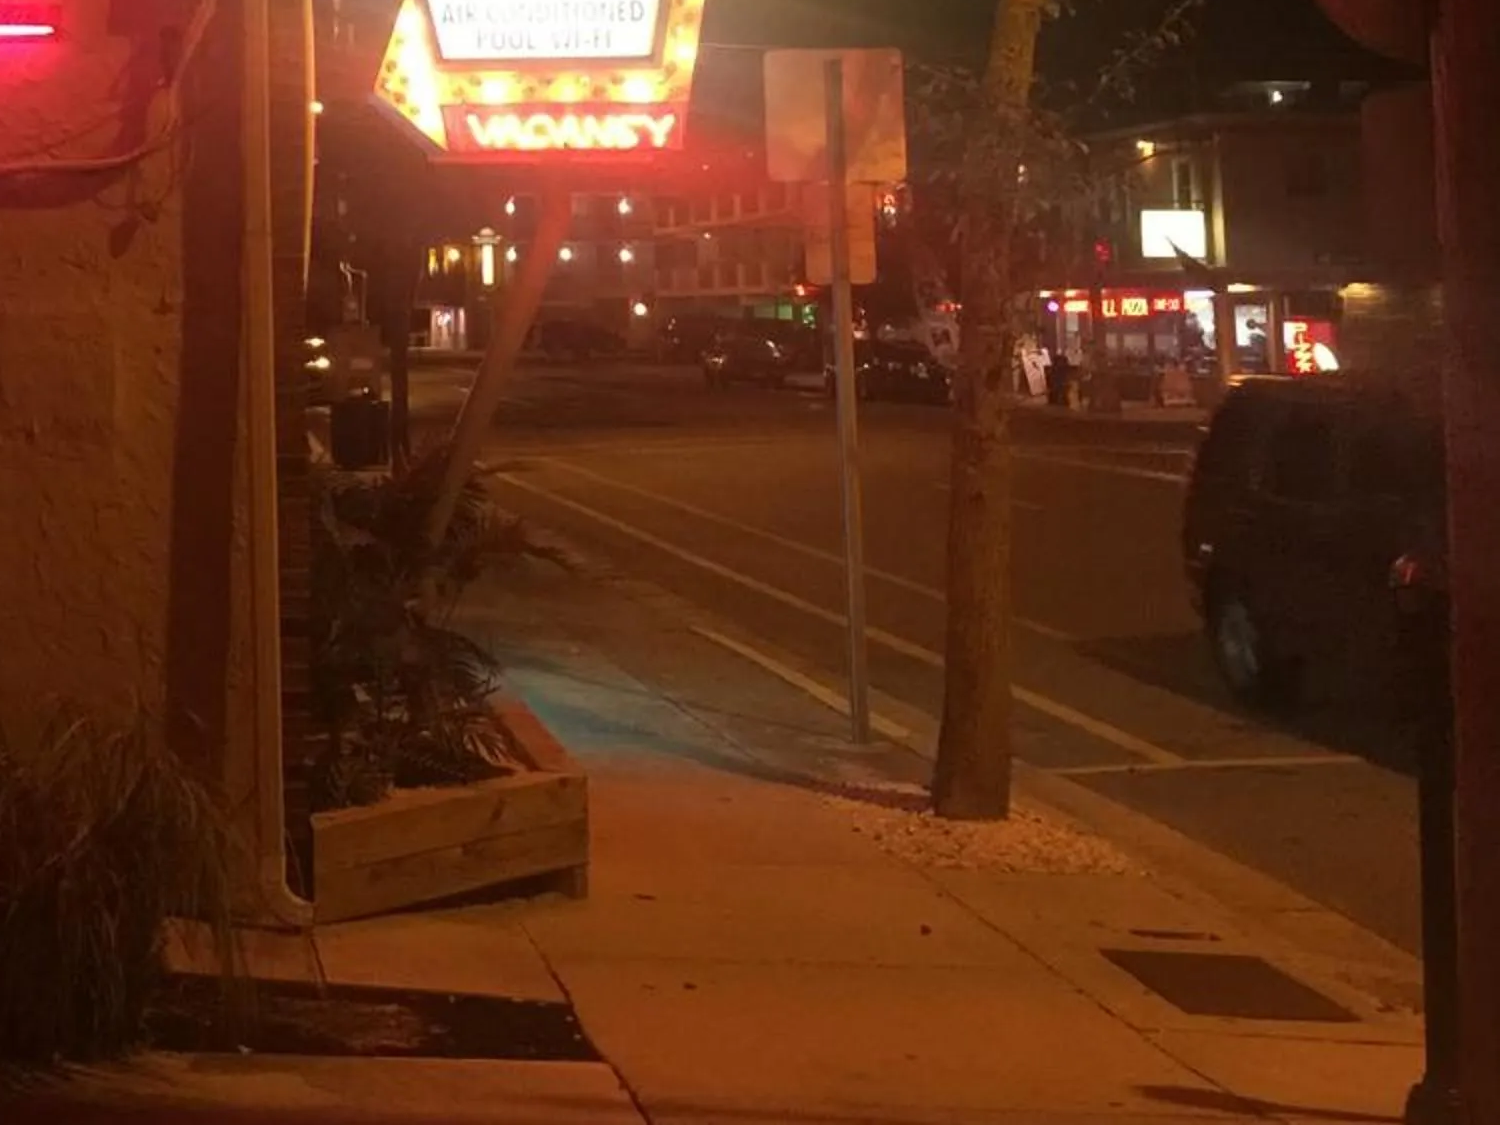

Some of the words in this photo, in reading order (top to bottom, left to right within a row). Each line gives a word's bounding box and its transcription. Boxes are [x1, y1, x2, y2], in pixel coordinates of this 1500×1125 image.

[441, 1, 477, 25] AIR
[485, 0, 646, 25] CONDITIONED
[476, 28, 537, 51] POOL
